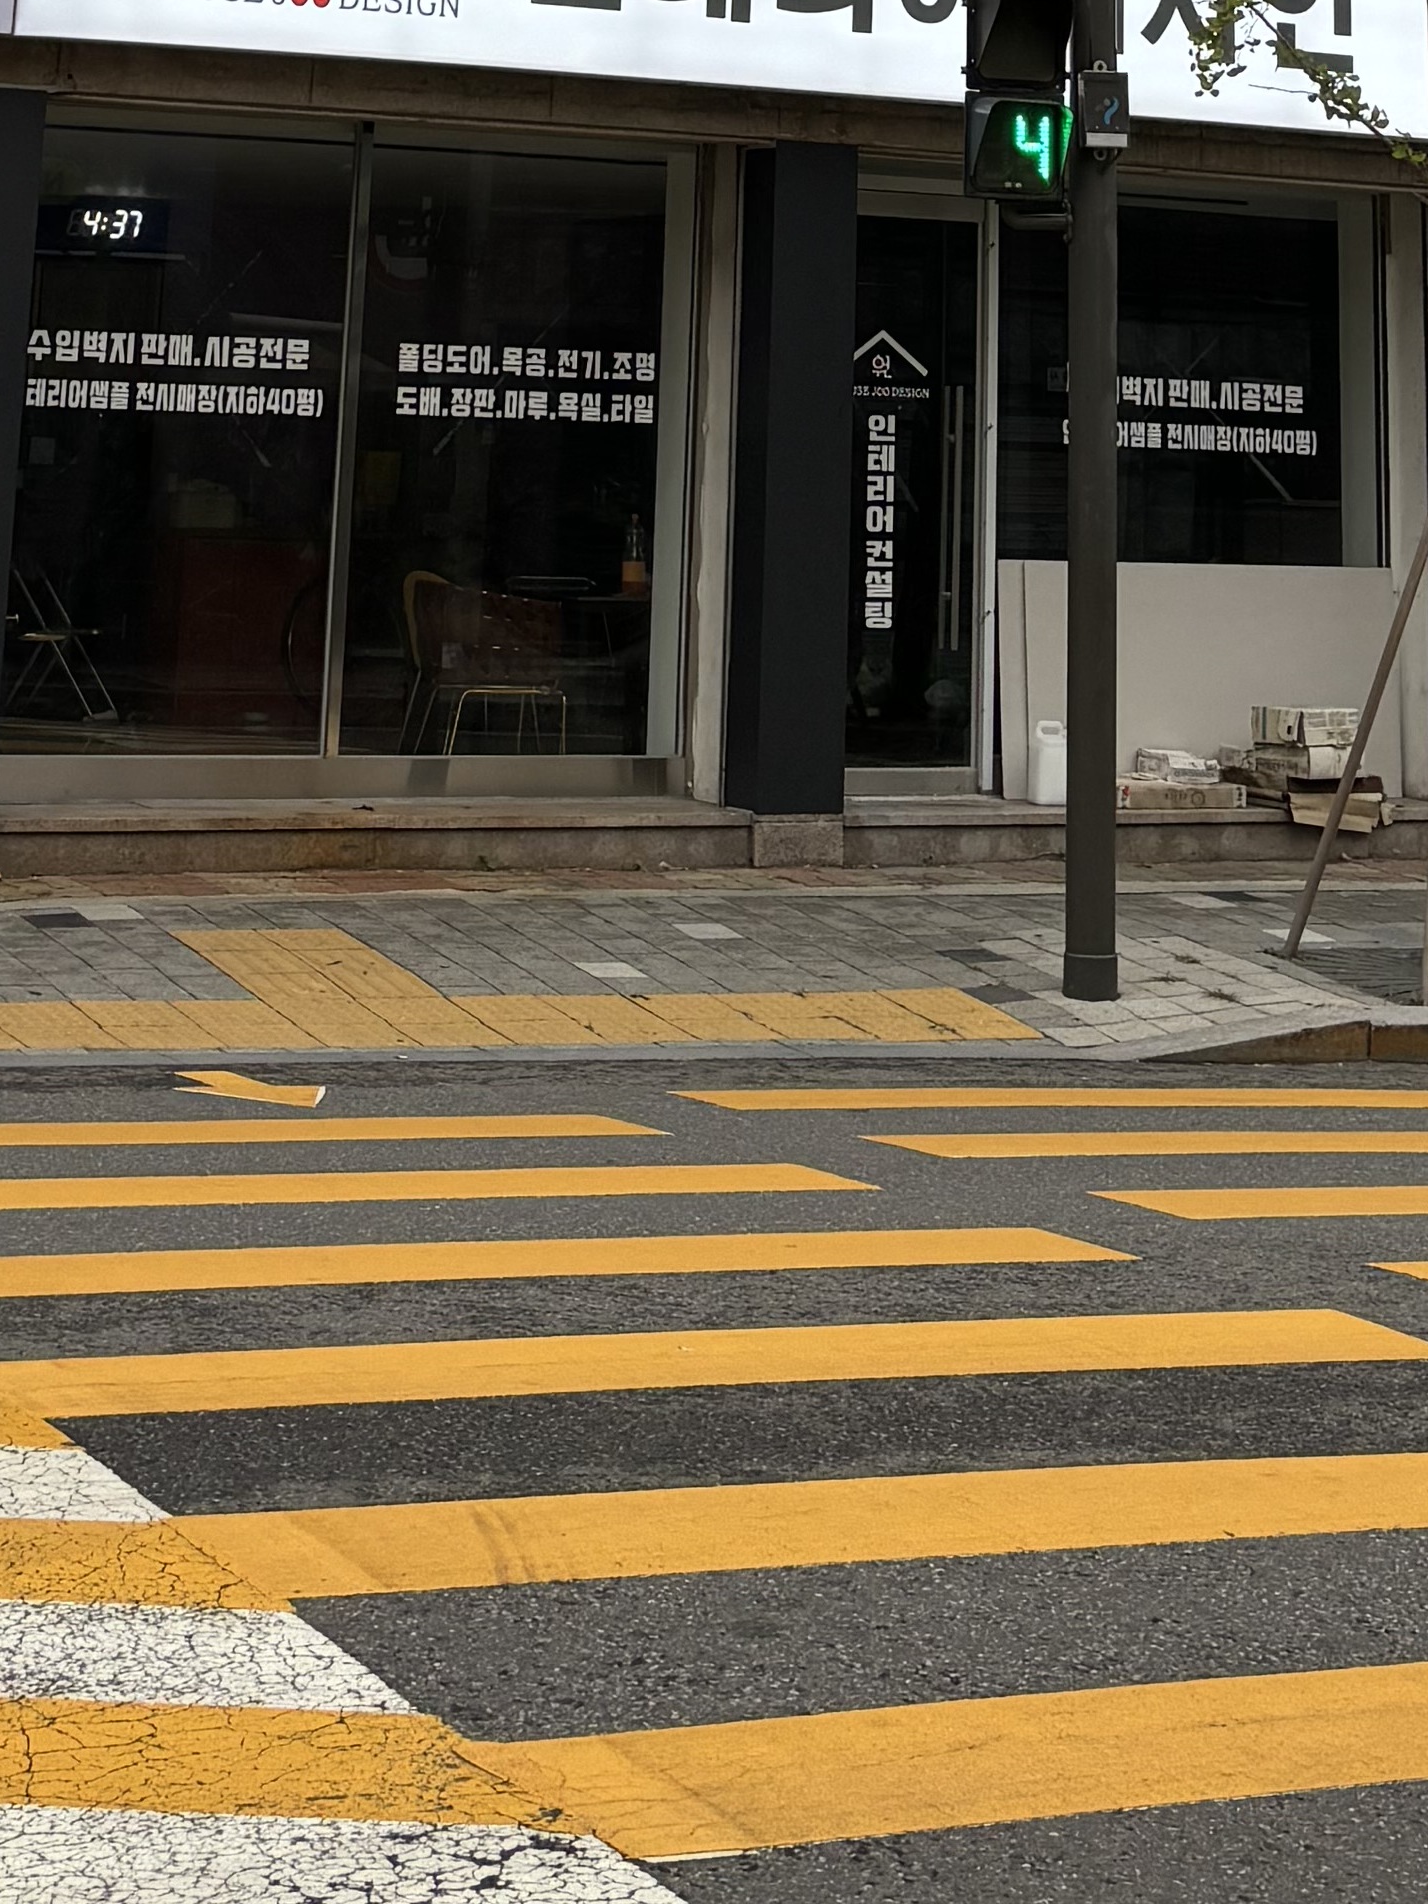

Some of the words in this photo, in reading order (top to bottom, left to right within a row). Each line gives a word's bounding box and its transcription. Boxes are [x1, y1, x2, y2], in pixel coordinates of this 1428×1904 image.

[1015, 114, 1052, 182] 4
[83, 209, 143, 239] 4:37
[26, 329, 136, 364] 수입벽지
[140, 332, 310, 370] 판매.시공전문
[871, 353, 893, 379] 원
[135, 381, 324, 418] 전시매장(지하40평)
[891, 386, 930, 399] DESIGN
[1167, 378, 1304, 414] 판매.시공전문
[1166, 423, 1318, 456] 전시매장(지하40평)
